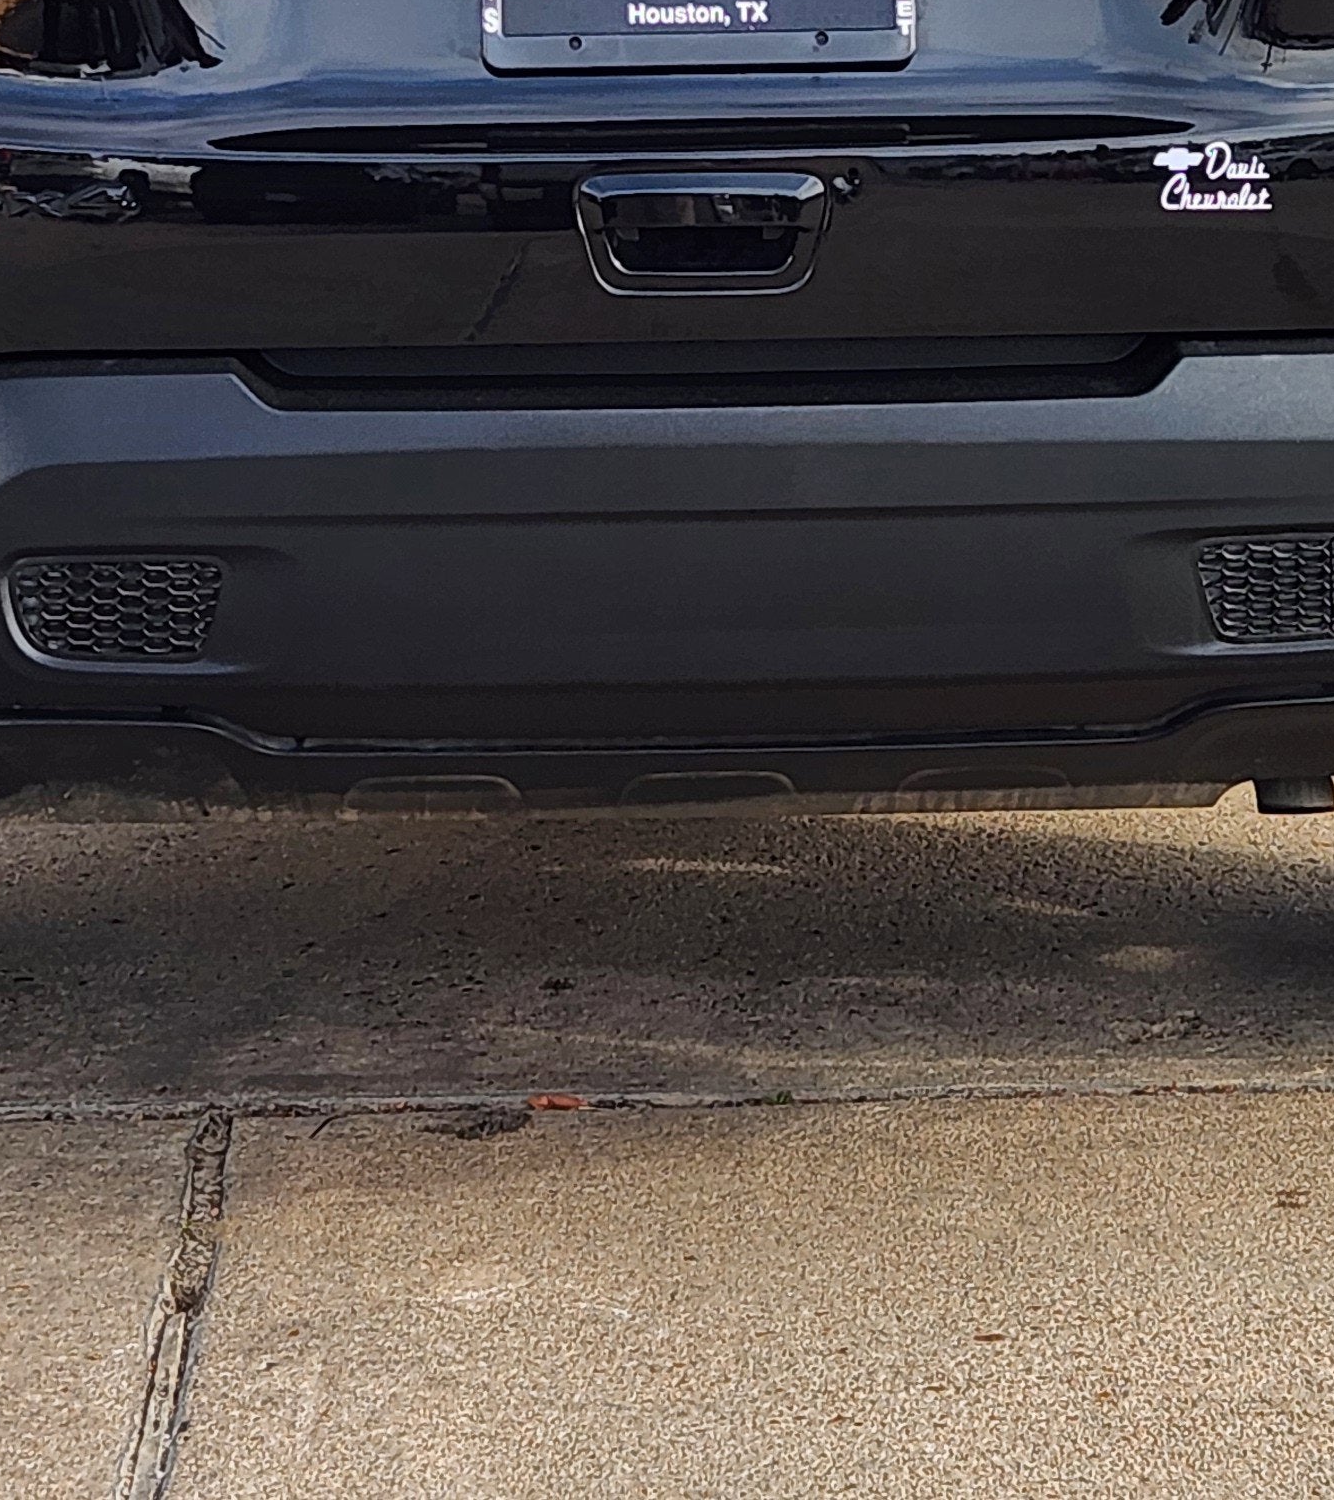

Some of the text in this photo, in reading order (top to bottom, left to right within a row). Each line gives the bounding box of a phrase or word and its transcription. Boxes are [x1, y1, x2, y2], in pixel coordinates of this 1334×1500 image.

[627, 0, 769, 28] Houston, TX
[1205, 141, 1270, 180] Davis
[1160, 173, 1273, 211] Chevrolet
